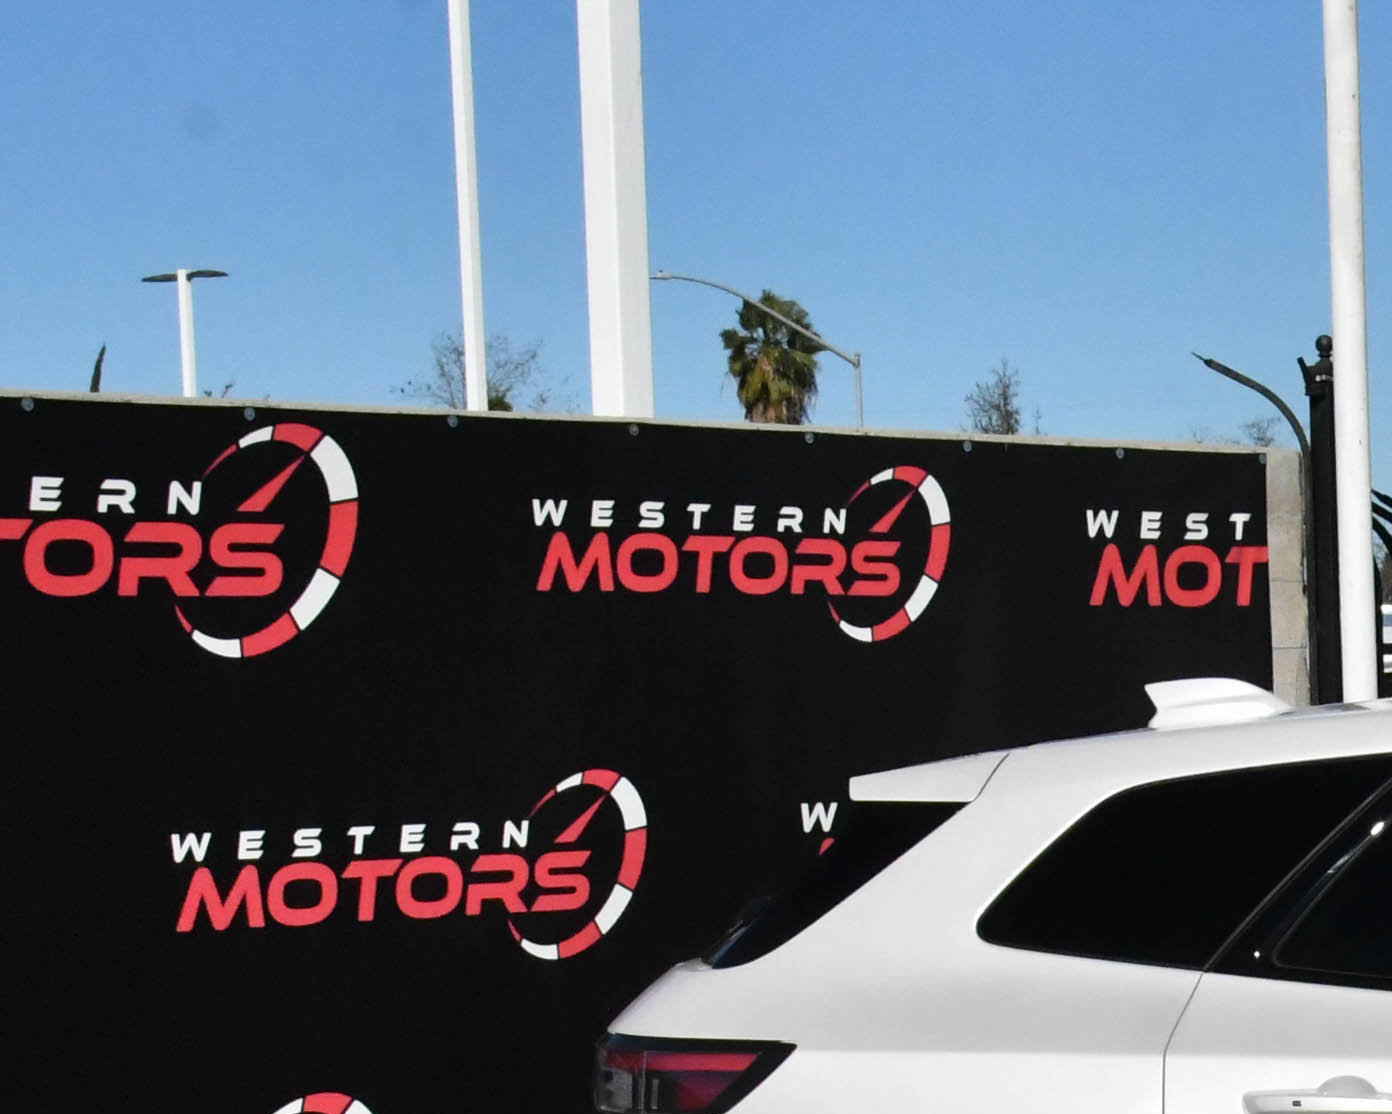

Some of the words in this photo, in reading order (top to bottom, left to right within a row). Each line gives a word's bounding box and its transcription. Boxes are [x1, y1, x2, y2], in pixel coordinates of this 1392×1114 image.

[533, 499, 846, 534] WESTERN
[1087, 510, 1250, 540] WEST
[536, 532, 900, 596] MOTORS
[171, 820, 529, 863] WESTERN
[176, 851, 591, 932] MOTORS
